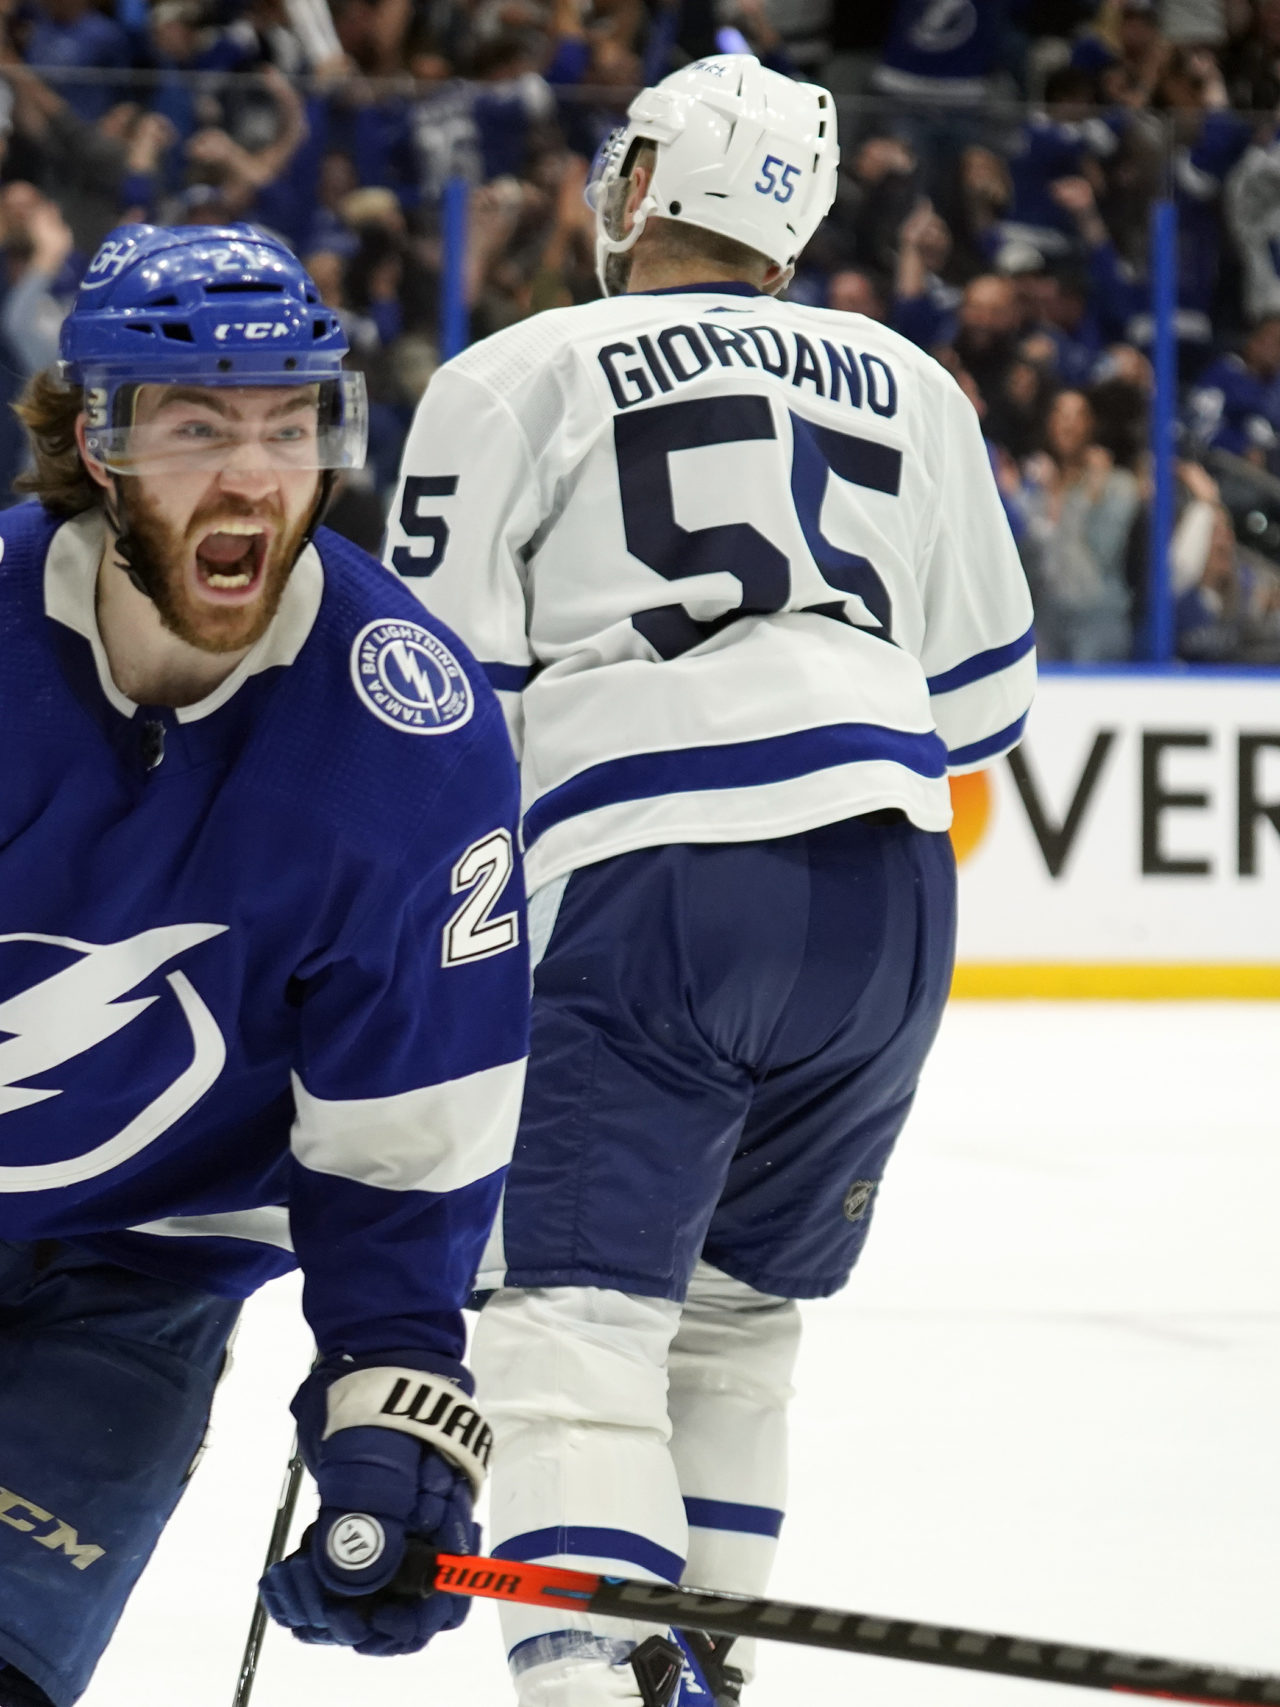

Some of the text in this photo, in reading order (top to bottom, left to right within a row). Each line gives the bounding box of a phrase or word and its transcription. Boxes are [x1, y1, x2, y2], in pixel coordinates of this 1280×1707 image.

[754, 154, 802, 204] 55
[597, 321, 899, 419] GIORDANO
[391, 474, 460, 578] 5
[613, 394, 903, 662] 55
[361, 640, 378, 675] BAY
[372, 625, 459, 678] LIGHTNING
[367, 679, 425, 724] TAMPA
[441, 827, 520, 968] 2
